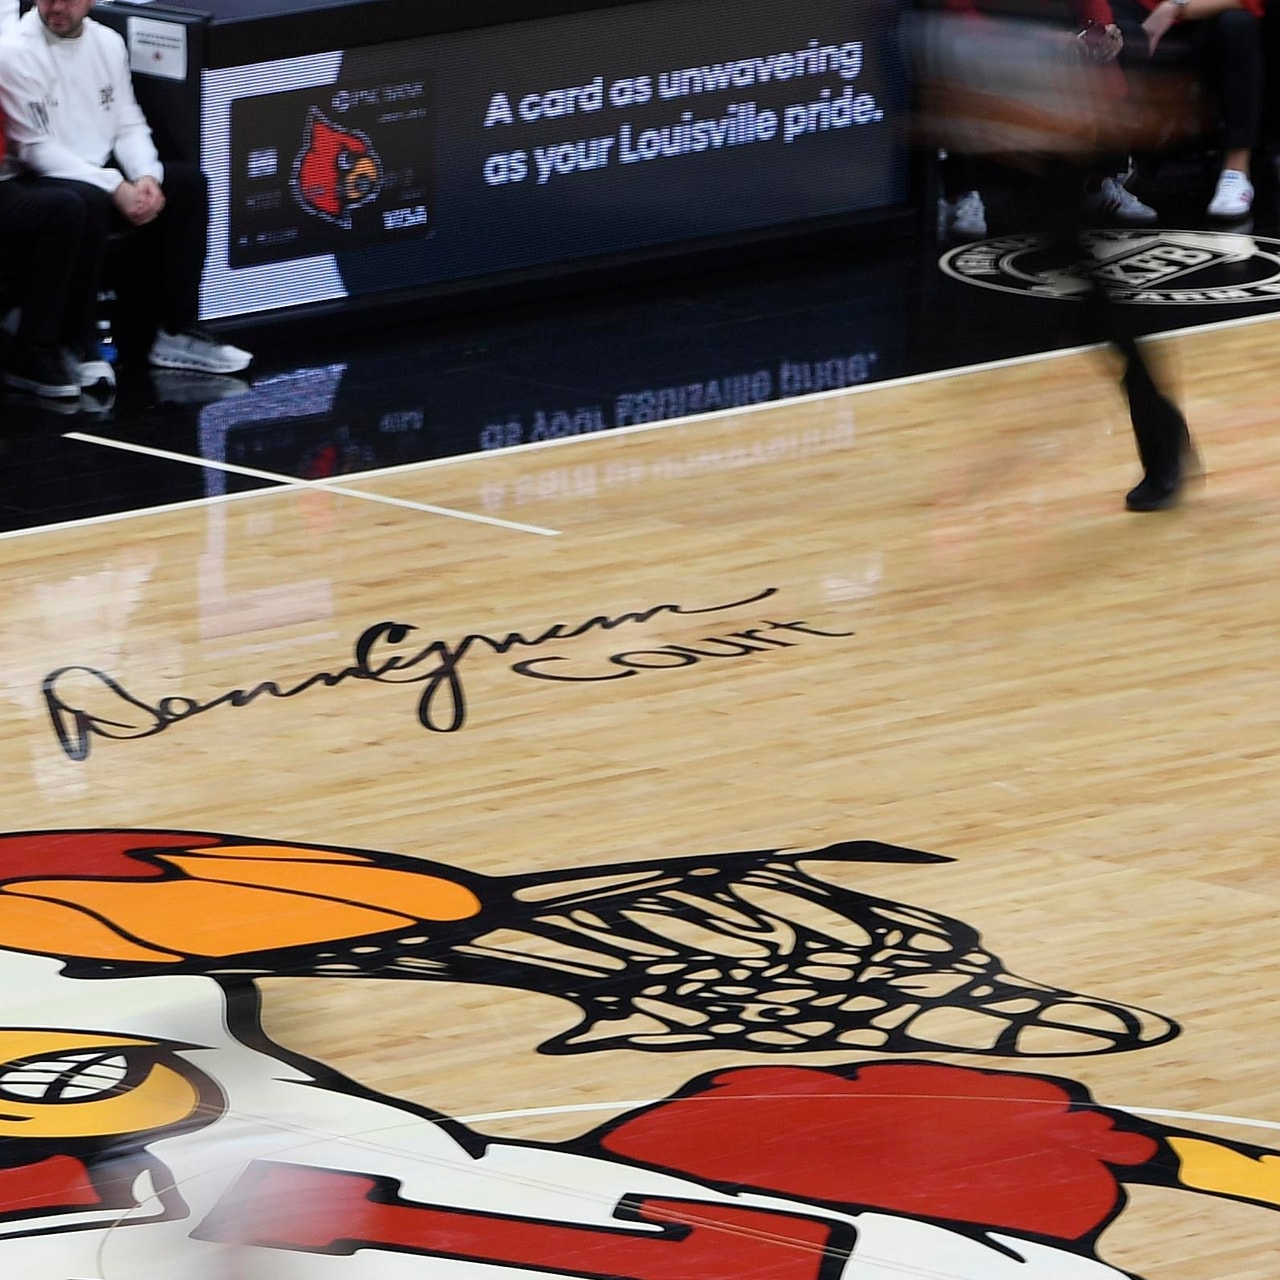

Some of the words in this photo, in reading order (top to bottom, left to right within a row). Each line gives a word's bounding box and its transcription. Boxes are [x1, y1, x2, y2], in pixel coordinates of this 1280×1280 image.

[483, 92, 514, 127] A
[518, 77, 604, 123] card
[608, 76, 653, 107] as
[658, 39, 864, 98] unwavering
[482, 150, 528, 186] as
[532, 135, 616, 184] your
[618, 101, 779, 164] Louisville
[783, 85, 885, 143] pride.
[511, 615, 856, 683] Court
